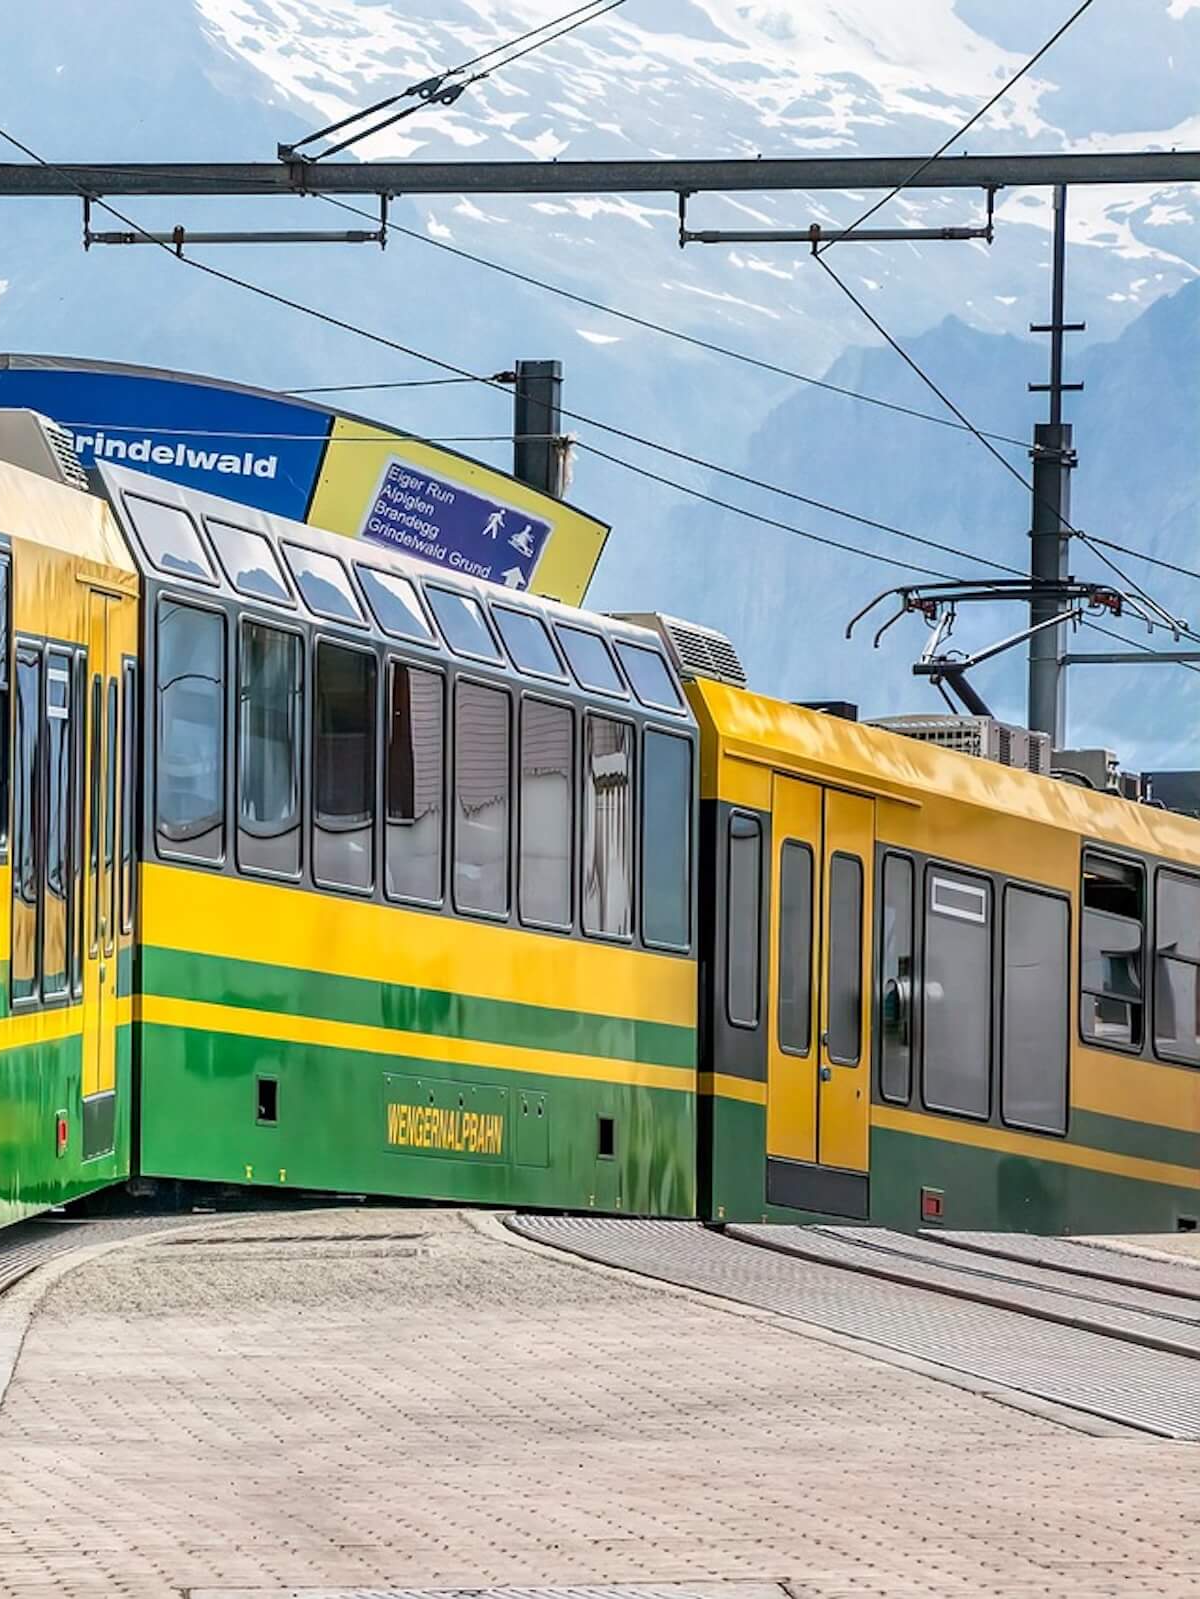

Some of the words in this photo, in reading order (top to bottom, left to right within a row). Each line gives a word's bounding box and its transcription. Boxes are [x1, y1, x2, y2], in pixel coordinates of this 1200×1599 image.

[380, 484, 436, 517] Alpiglen
[388, 466, 424, 491] Eiger
[426, 482, 455, 505] Run
[373, 500, 440, 539] Brandegg
[367, 518, 447, 560] Grindelwald
[449, 552, 492, 579] Grund
[388, 1104, 504, 1154] WENGERNALPBAHN
